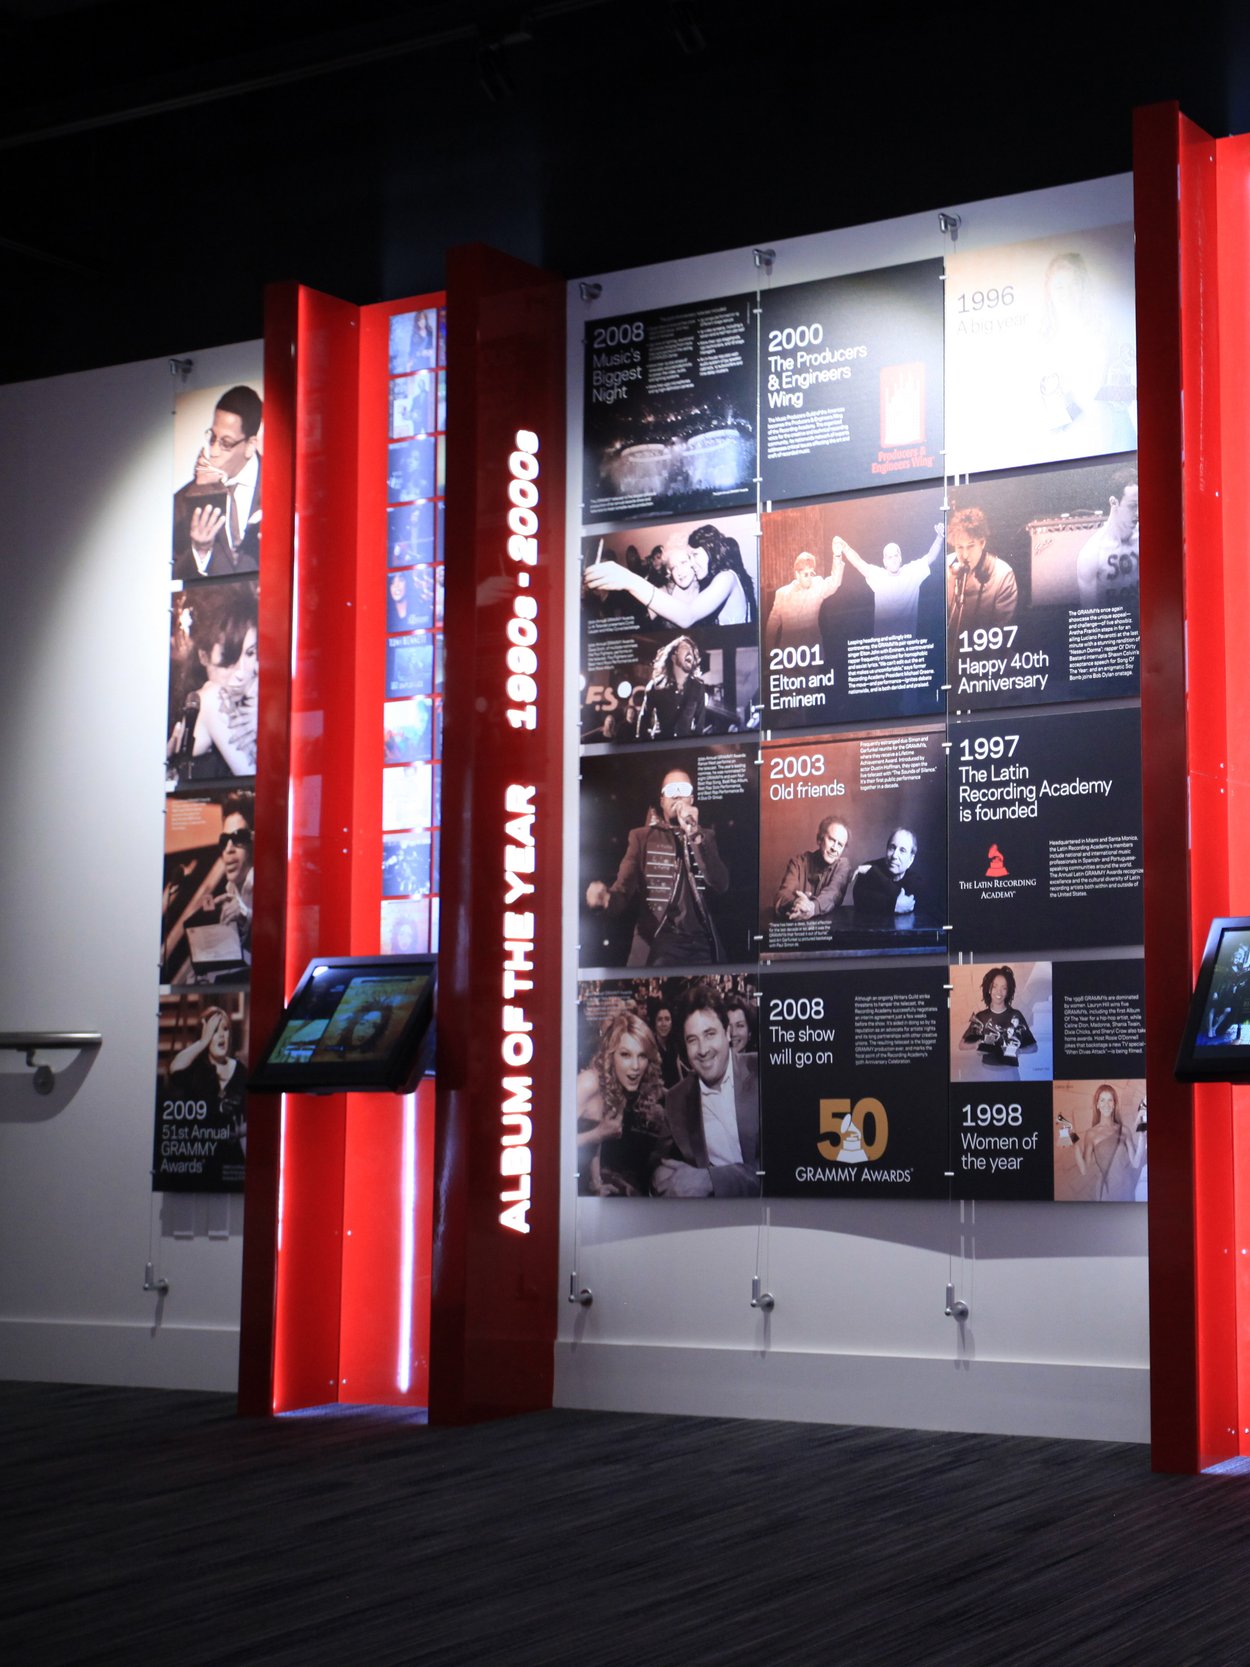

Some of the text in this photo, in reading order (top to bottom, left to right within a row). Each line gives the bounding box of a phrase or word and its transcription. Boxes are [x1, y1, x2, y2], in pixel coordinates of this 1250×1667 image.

[957, 285, 1015, 314] 1996
[593, 322, 644, 348] 2008
[768, 323, 823, 352] 2000
[592, 348, 641, 368] Music's
[768, 346, 868, 373] The Producers
[592, 366, 643, 387] Biggest
[768, 366, 851, 391] & Engineers
[592, 385, 628, 404] Night
[768, 392, 803, 409] Wing
[507, 429, 539, 566] 2000s
[958, 625, 1018, 652] 1997
[506, 596, 538, 730] 1990s
[770, 644, 824, 670] 2001
[958, 650, 1049, 676] Happy 40th
[770, 668, 834, 692] Elton and
[958, 674, 1049, 694] Anniversary
[770, 693, 826, 710] Eminem
[959, 735, 1020, 761] 1997
[770, 754, 825, 779] 2003
[958, 763, 1029, 784] The Latin
[770, 779, 846, 801] Old friends
[959, 777, 1113, 803] Recording Academy
[959, 800, 1038, 822] is founded
[504, 783, 536, 904] YEAR
[958, 878, 1036, 890] THE LATIN RECORDING
[980, 890, 1014, 900] ACADEMY
[503, 912, 535, 998] THE
[769, 998, 824, 1020] 2008
[502, 1006, 534, 1067] OF
[769, 1026, 835, 1042] The show
[770, 1048, 833, 1068] will go on
[162, 1100, 207, 1120] 2009
[962, 1104, 1022, 1127] 1998
[162, 1124, 230, 1140] 51st Annual
[816, 1097, 889, 1163] 50
[961, 1132, 1038, 1150] Women of
[161, 1141, 217, 1156] GRAMMY
[500, 1076, 533, 1234] ALBUM
[160, 1158, 203, 1173] Awards
[796, 1166, 858, 1182] GRAMMY
[961, 1153, 1024, 1174] the year
